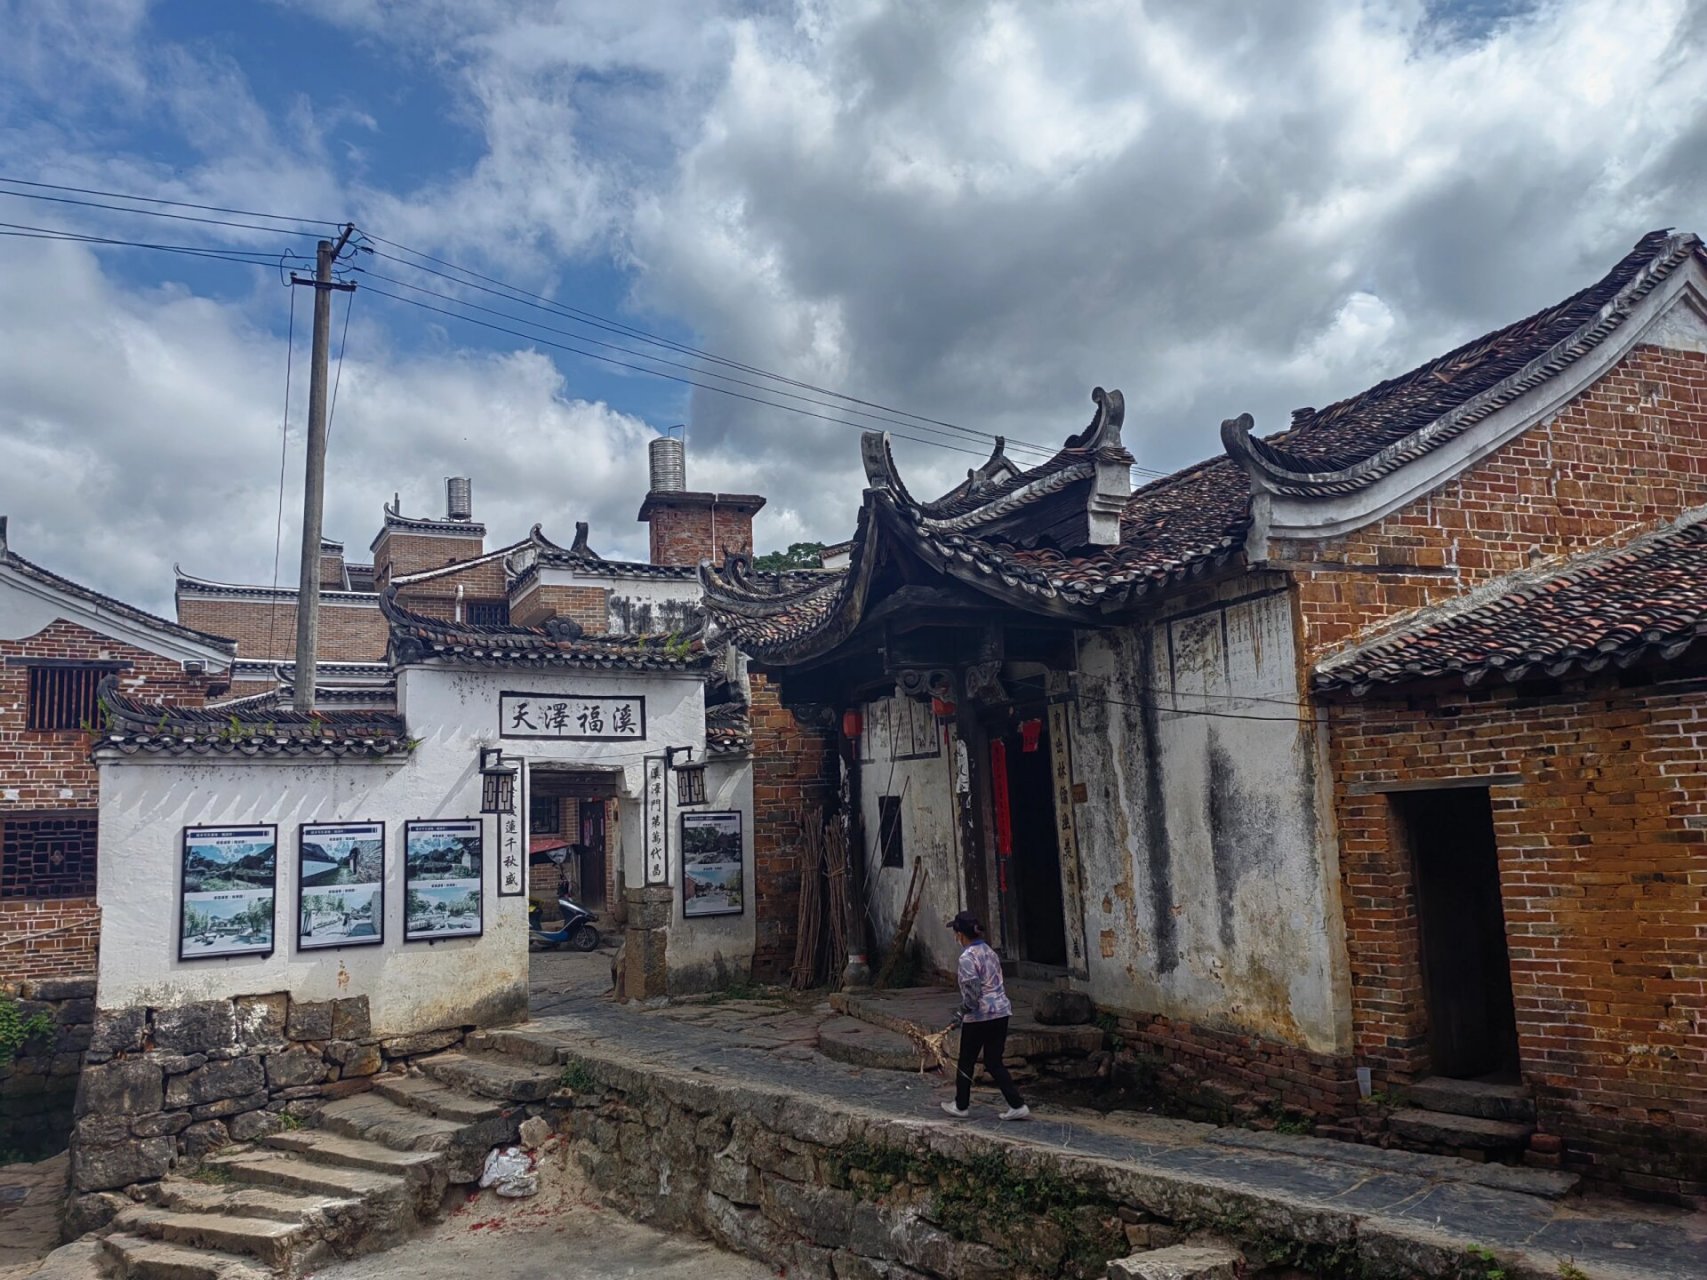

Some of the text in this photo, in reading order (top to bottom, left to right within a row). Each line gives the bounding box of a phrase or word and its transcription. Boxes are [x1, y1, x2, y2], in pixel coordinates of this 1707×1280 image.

[511, 702, 637, 734] 天澤福溪
[503, 767, 519, 887] 蓮千秋盛
